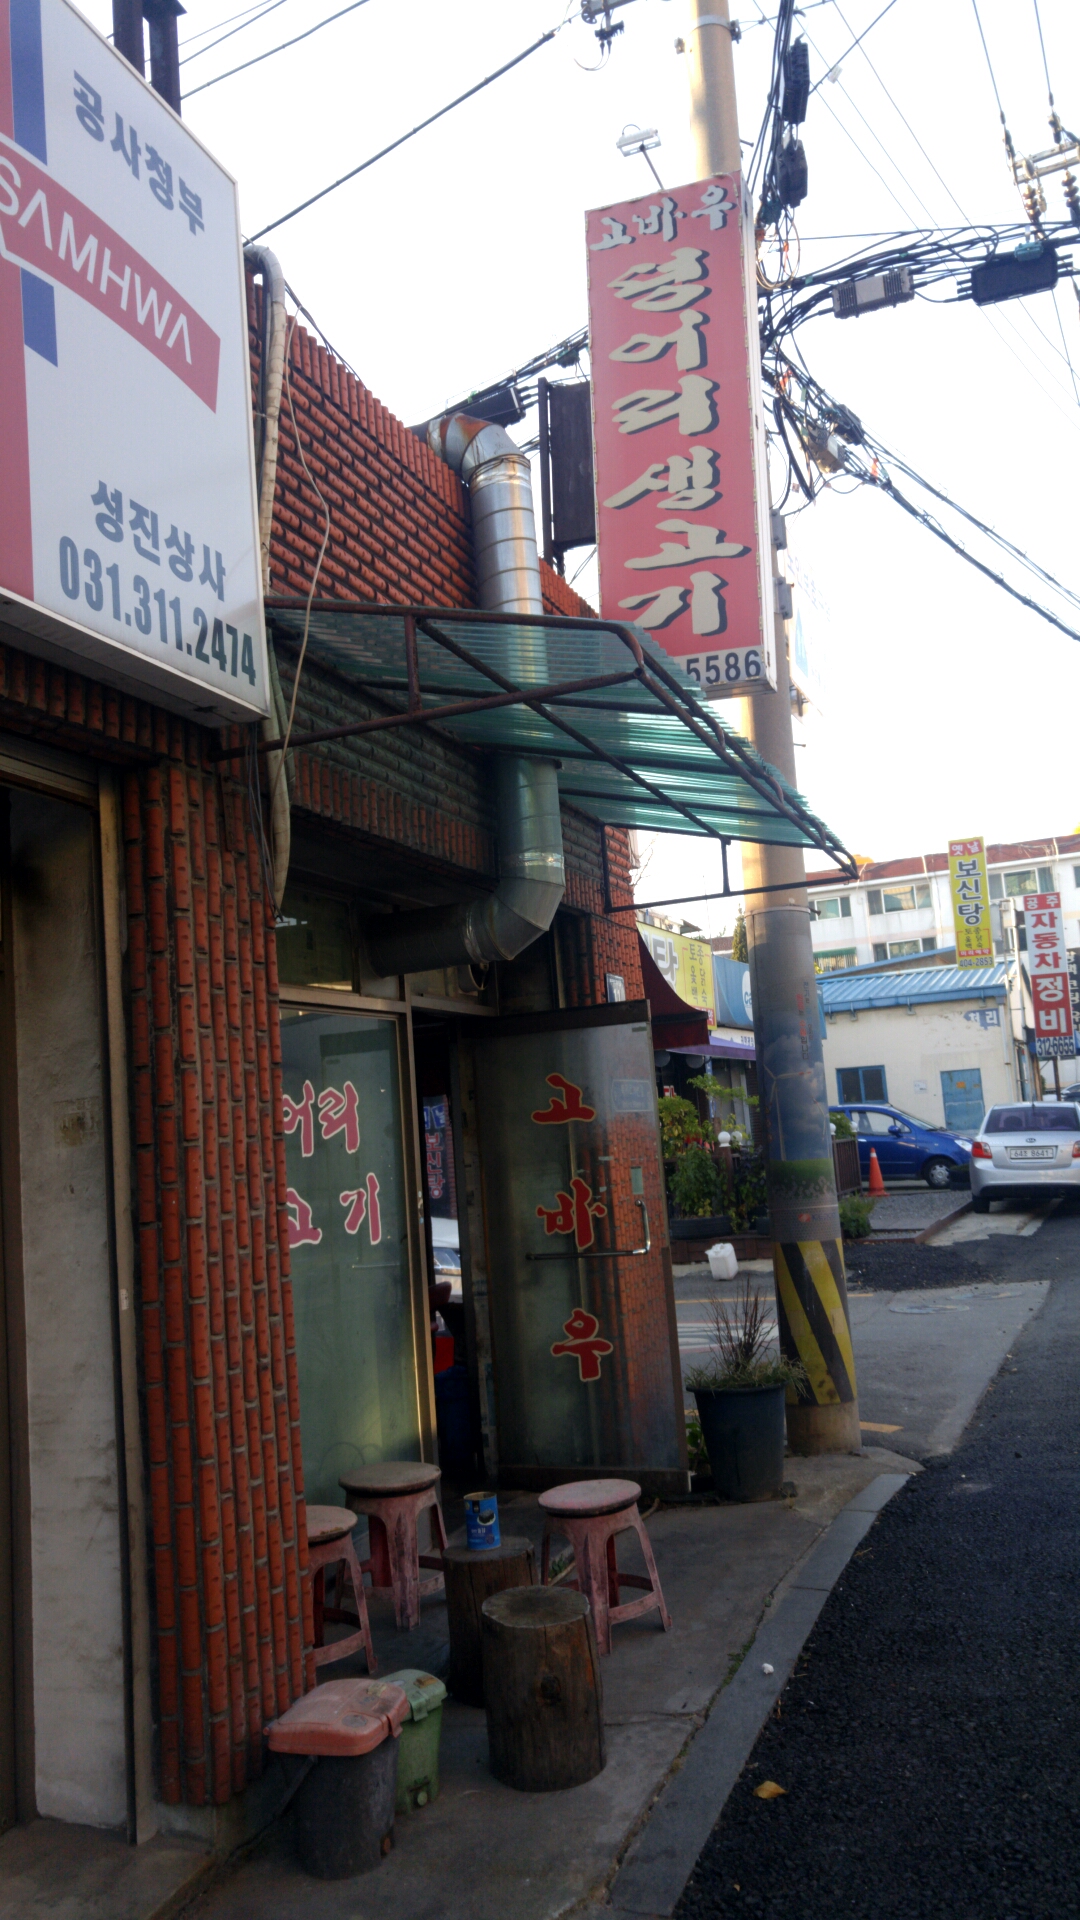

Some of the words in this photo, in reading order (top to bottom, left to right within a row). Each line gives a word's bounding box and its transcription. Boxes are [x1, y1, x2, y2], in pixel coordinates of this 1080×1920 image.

[590, 185, 738, 251] 고바우
[91, 480, 226, 602] 성진상사
[59, 535, 256, 686] 031.311.2474
[686, 650, 761, 684] 5586
[955, 859, 984, 927] 보신탕
[1037, 1036, 1074, 1056] 312-6655
[531, 1073, 613, 1381] 고바우
